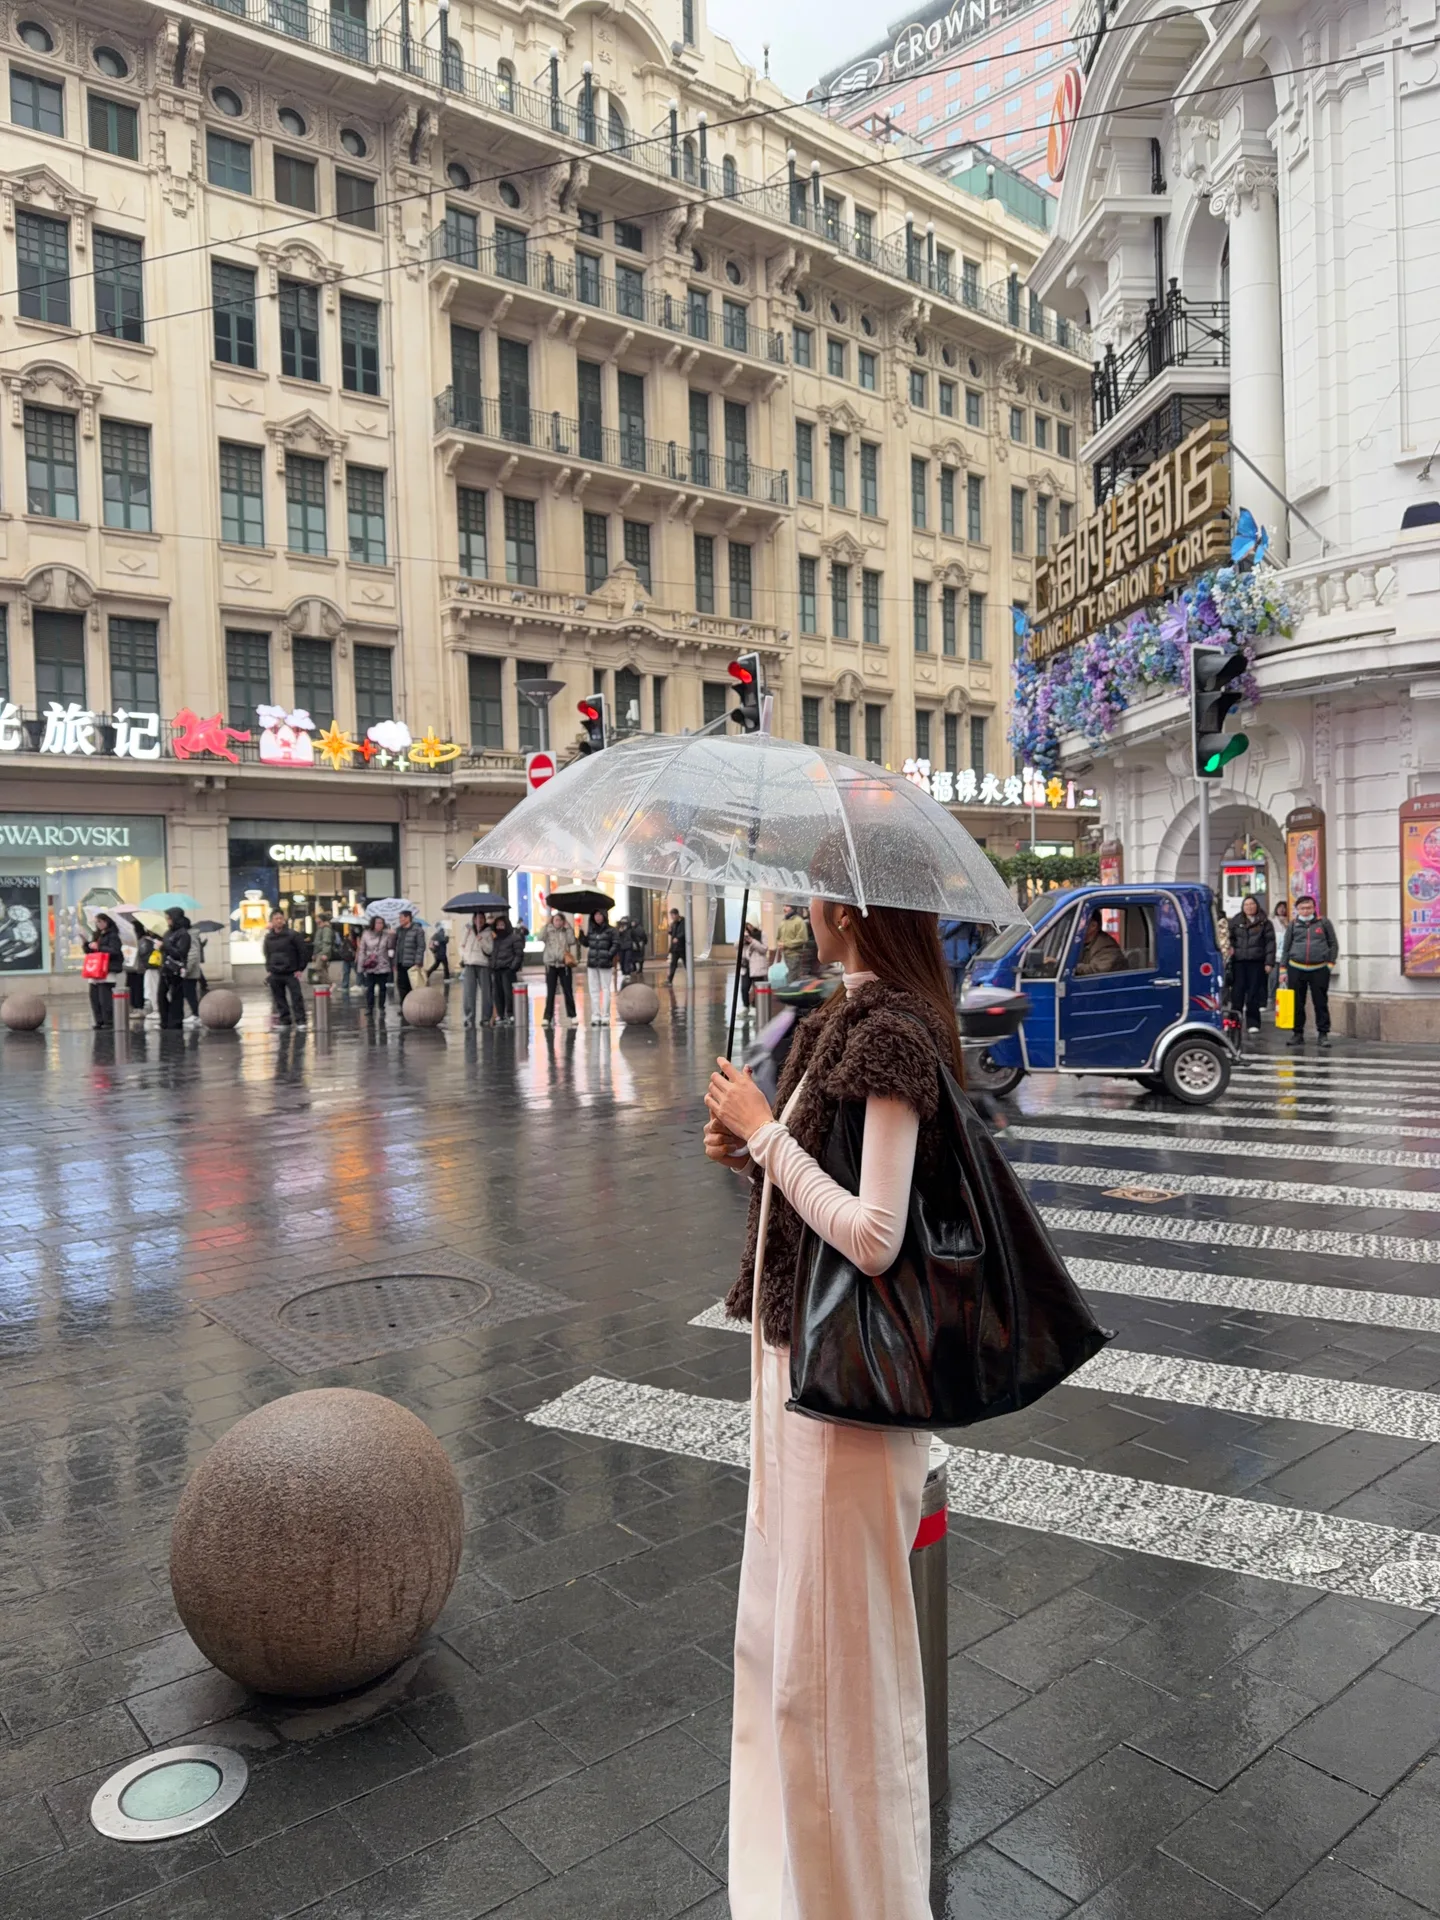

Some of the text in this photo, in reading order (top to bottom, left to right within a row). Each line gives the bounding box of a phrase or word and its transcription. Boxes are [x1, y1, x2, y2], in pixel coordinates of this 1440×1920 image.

[893, 0, 1002, 68] CROWNE
[1032, 420, 1220, 624] 上海时装商店
[1027, 520, 1219, 662] SHANGHAI FASHION STORE
[931, 768, 1023, 806] 福禄永安
[269, 844, 358, 862] CHANEL
